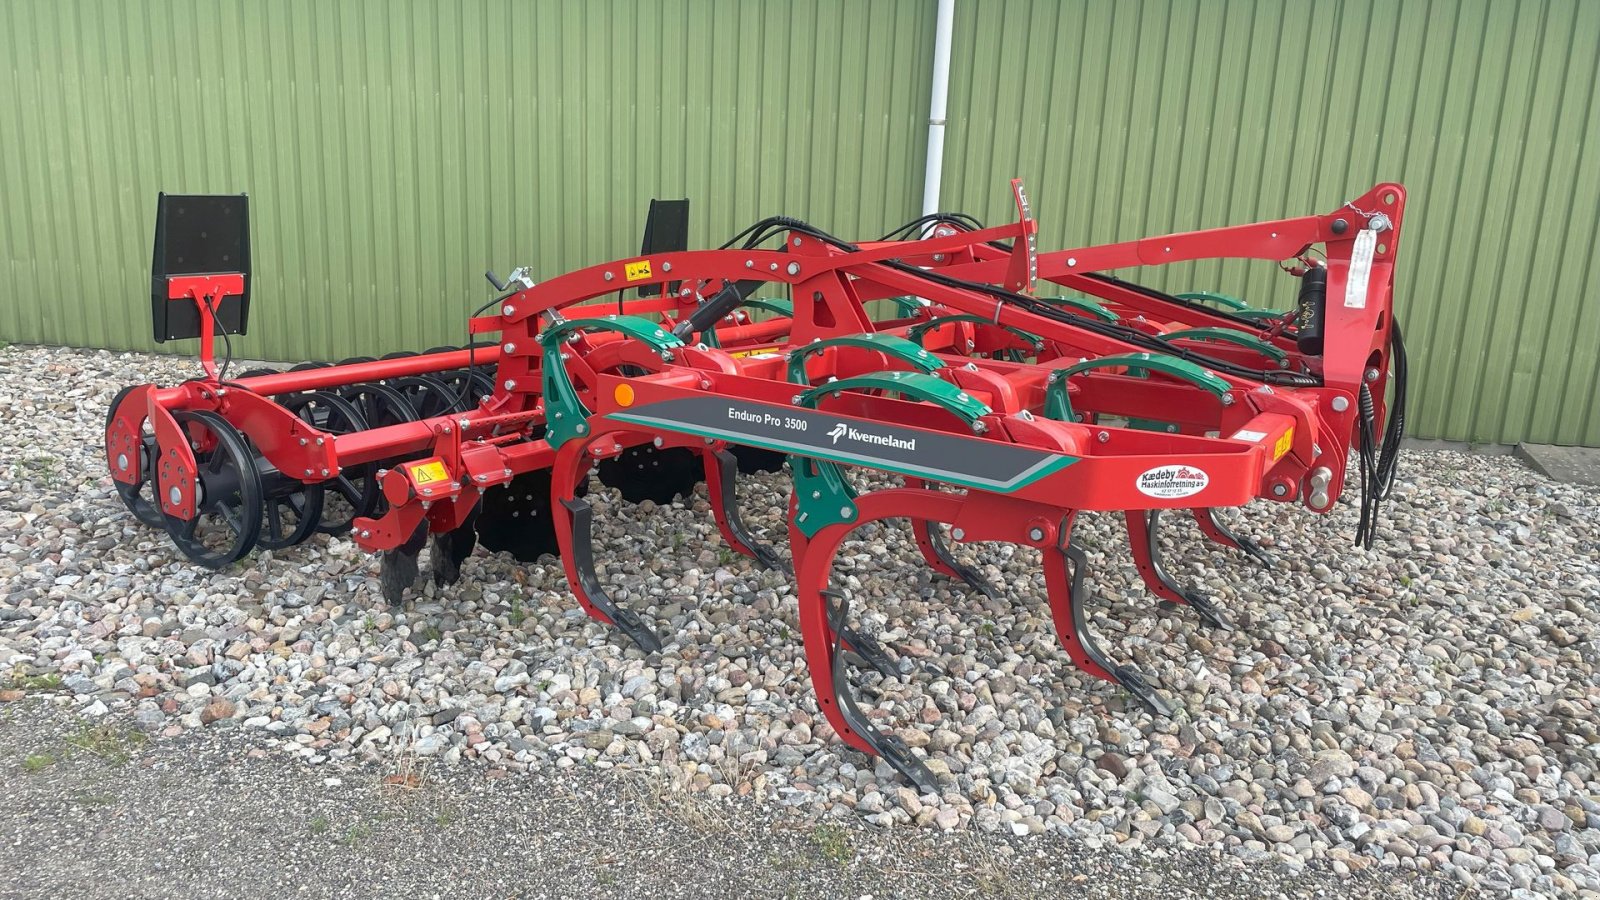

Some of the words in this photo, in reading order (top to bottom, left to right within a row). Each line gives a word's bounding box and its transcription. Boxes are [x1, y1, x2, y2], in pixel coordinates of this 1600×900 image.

[728, 407, 762, 424] Enduro
[764, 413, 781, 427] Pro
[784, 417, 808, 432] 3500
[848, 427, 916, 450] Kverneland
[1142, 469, 1176, 481] Kædeby
[1141, 480, 1196, 488] Maskinforretning
